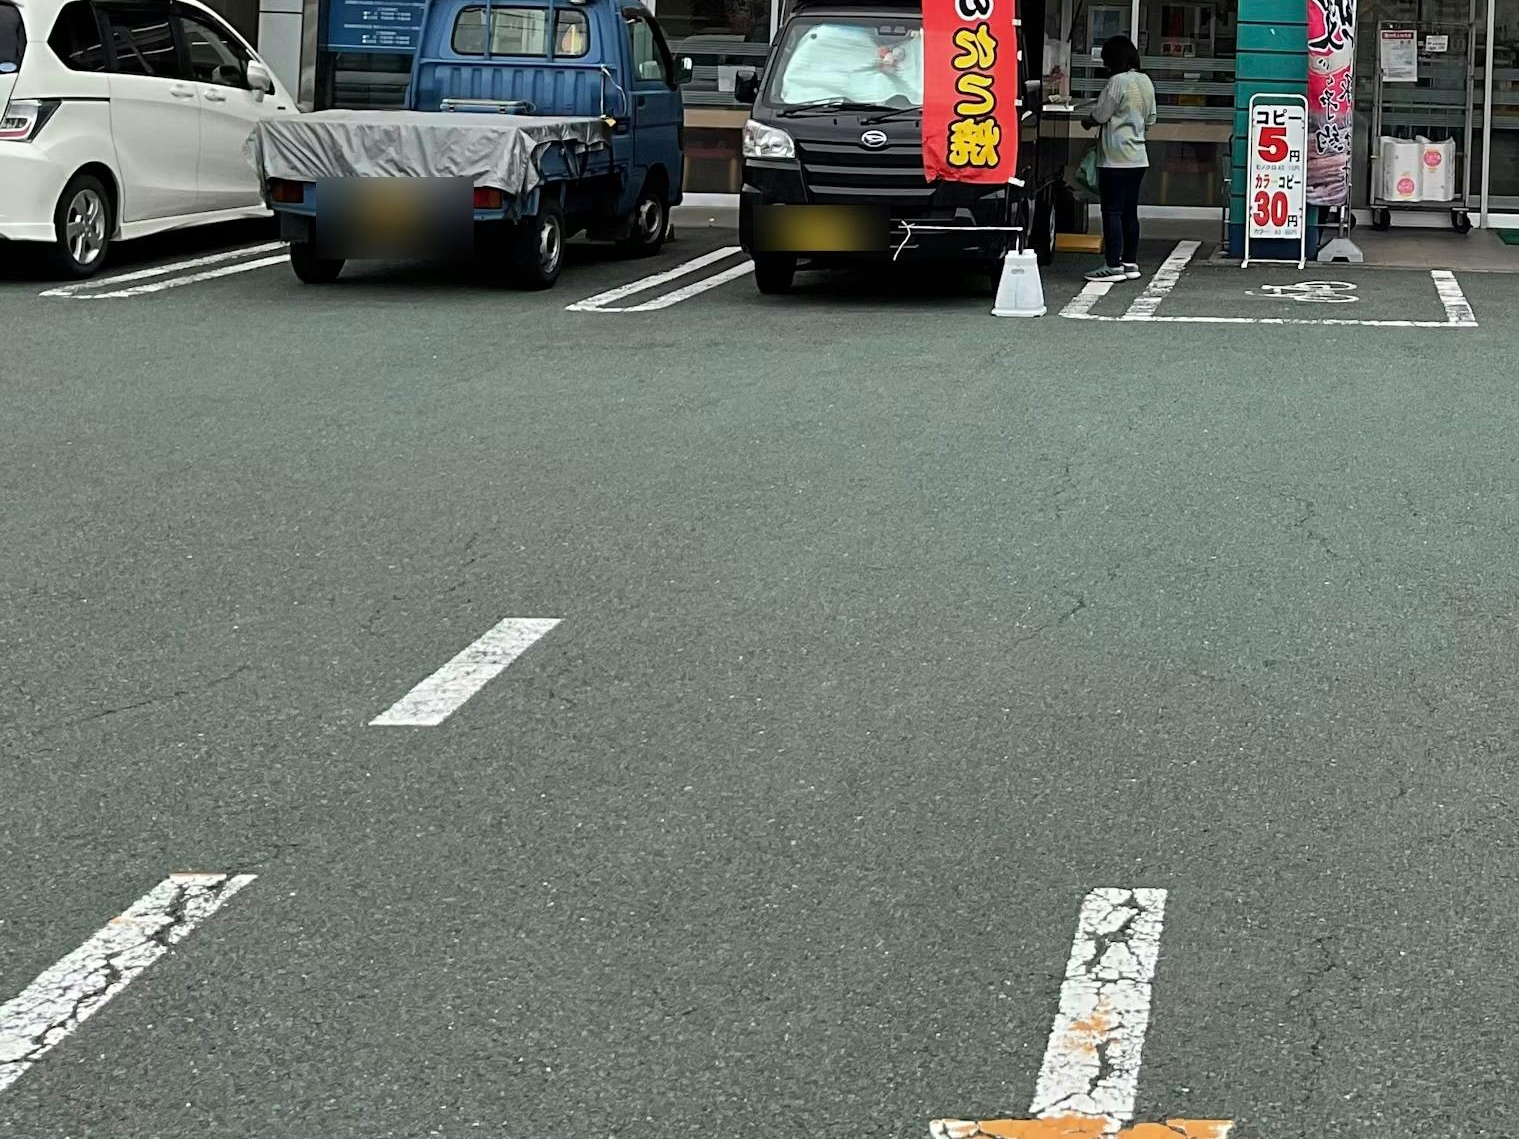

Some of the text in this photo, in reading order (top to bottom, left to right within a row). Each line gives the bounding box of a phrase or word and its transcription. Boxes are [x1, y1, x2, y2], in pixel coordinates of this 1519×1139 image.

[1256, 109, 1302, 126] コピー
[1258, 127, 1300, 163] 5円
[1253, 191, 1298, 227] 30円
